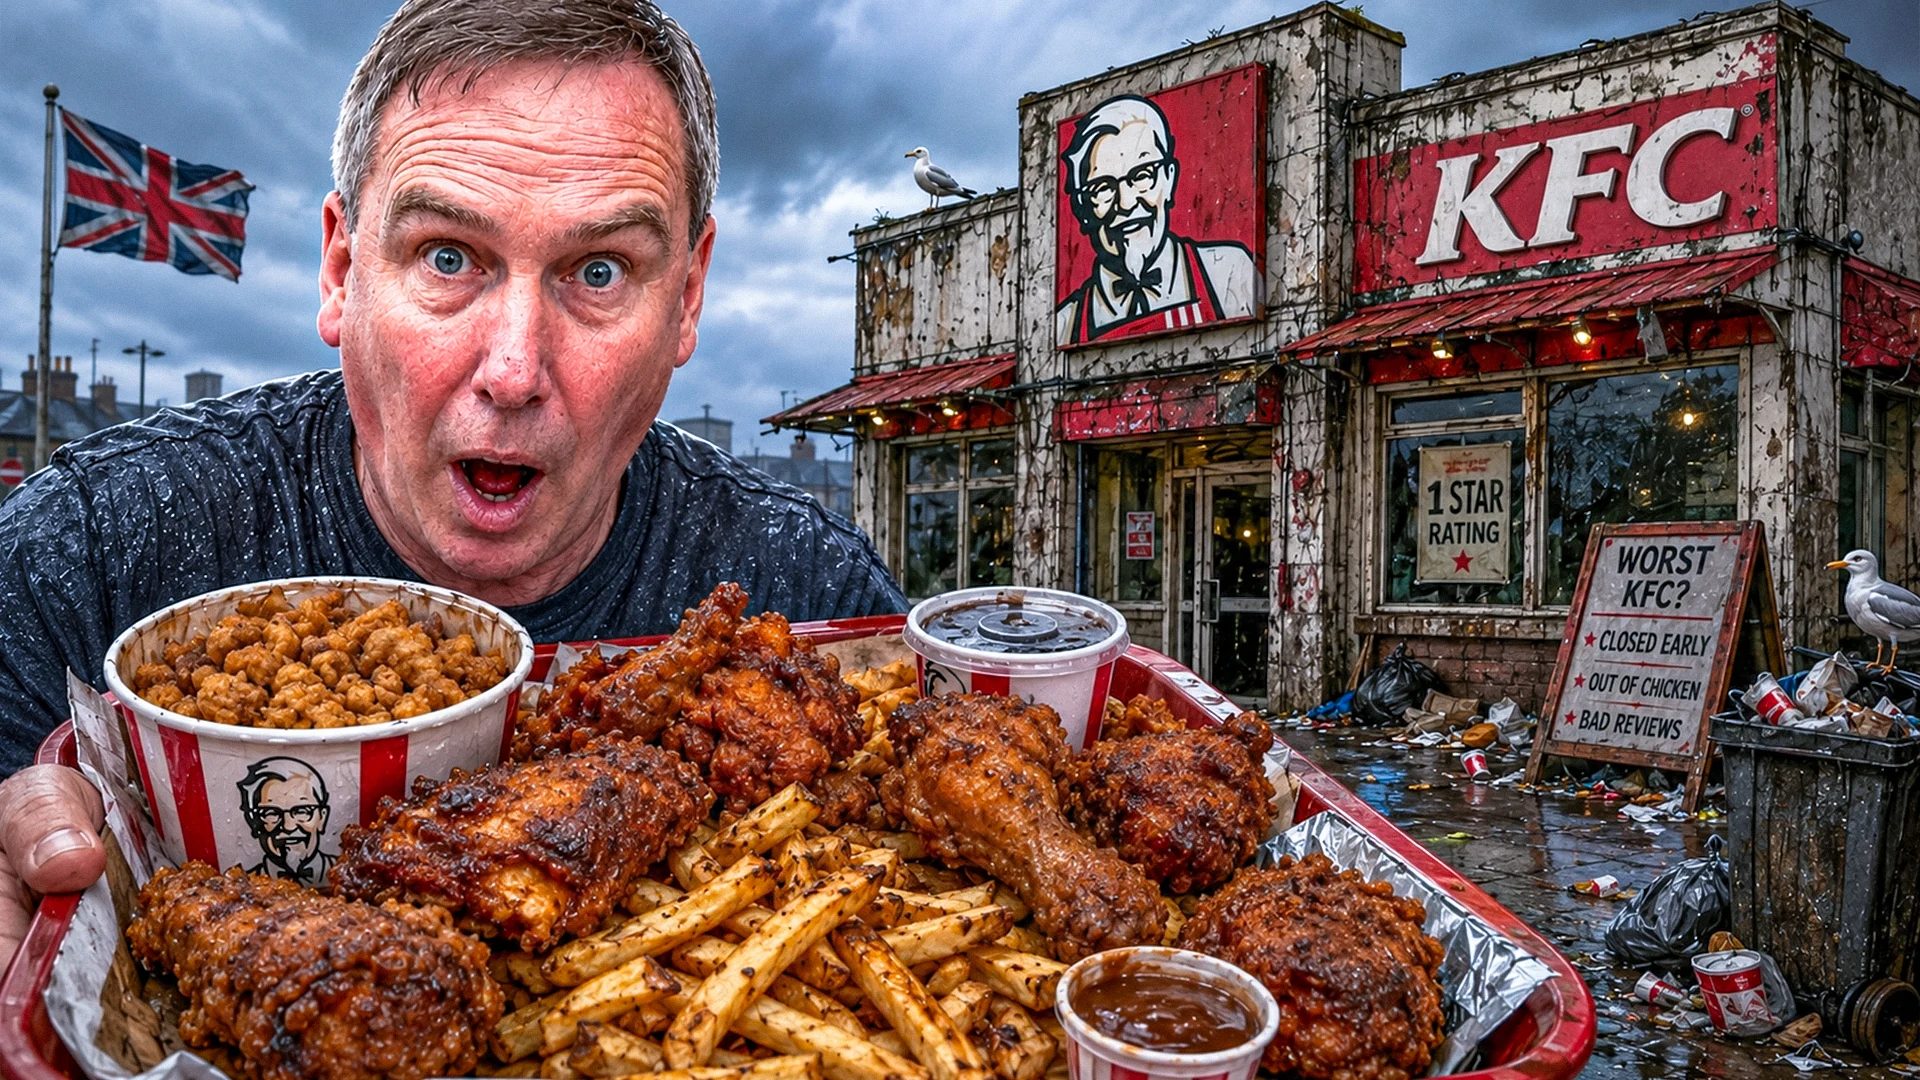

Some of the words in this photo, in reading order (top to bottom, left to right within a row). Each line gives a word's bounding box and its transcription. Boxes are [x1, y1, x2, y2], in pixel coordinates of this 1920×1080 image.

[1415, 107, 1740, 266] KFC
[1427, 480, 1444, 515] 1
[1450, 479, 1504, 515] STAR
[1429, 521, 1500, 545] RATING
[1617, 545, 1715, 575] WORST
[1621, 579, 1691, 609] KFC?
[1599, 630, 1657, 654] CLOSED
[1660, 633, 1712, 657] EARLY
[1588, 672, 1618, 692] OUT
[1619, 674, 1640, 695] OF
[1641, 676, 1702, 701] CHICKEN
[1578, 709, 1610, 731] BAD
[1614, 713, 1683, 740] REVIEWS
